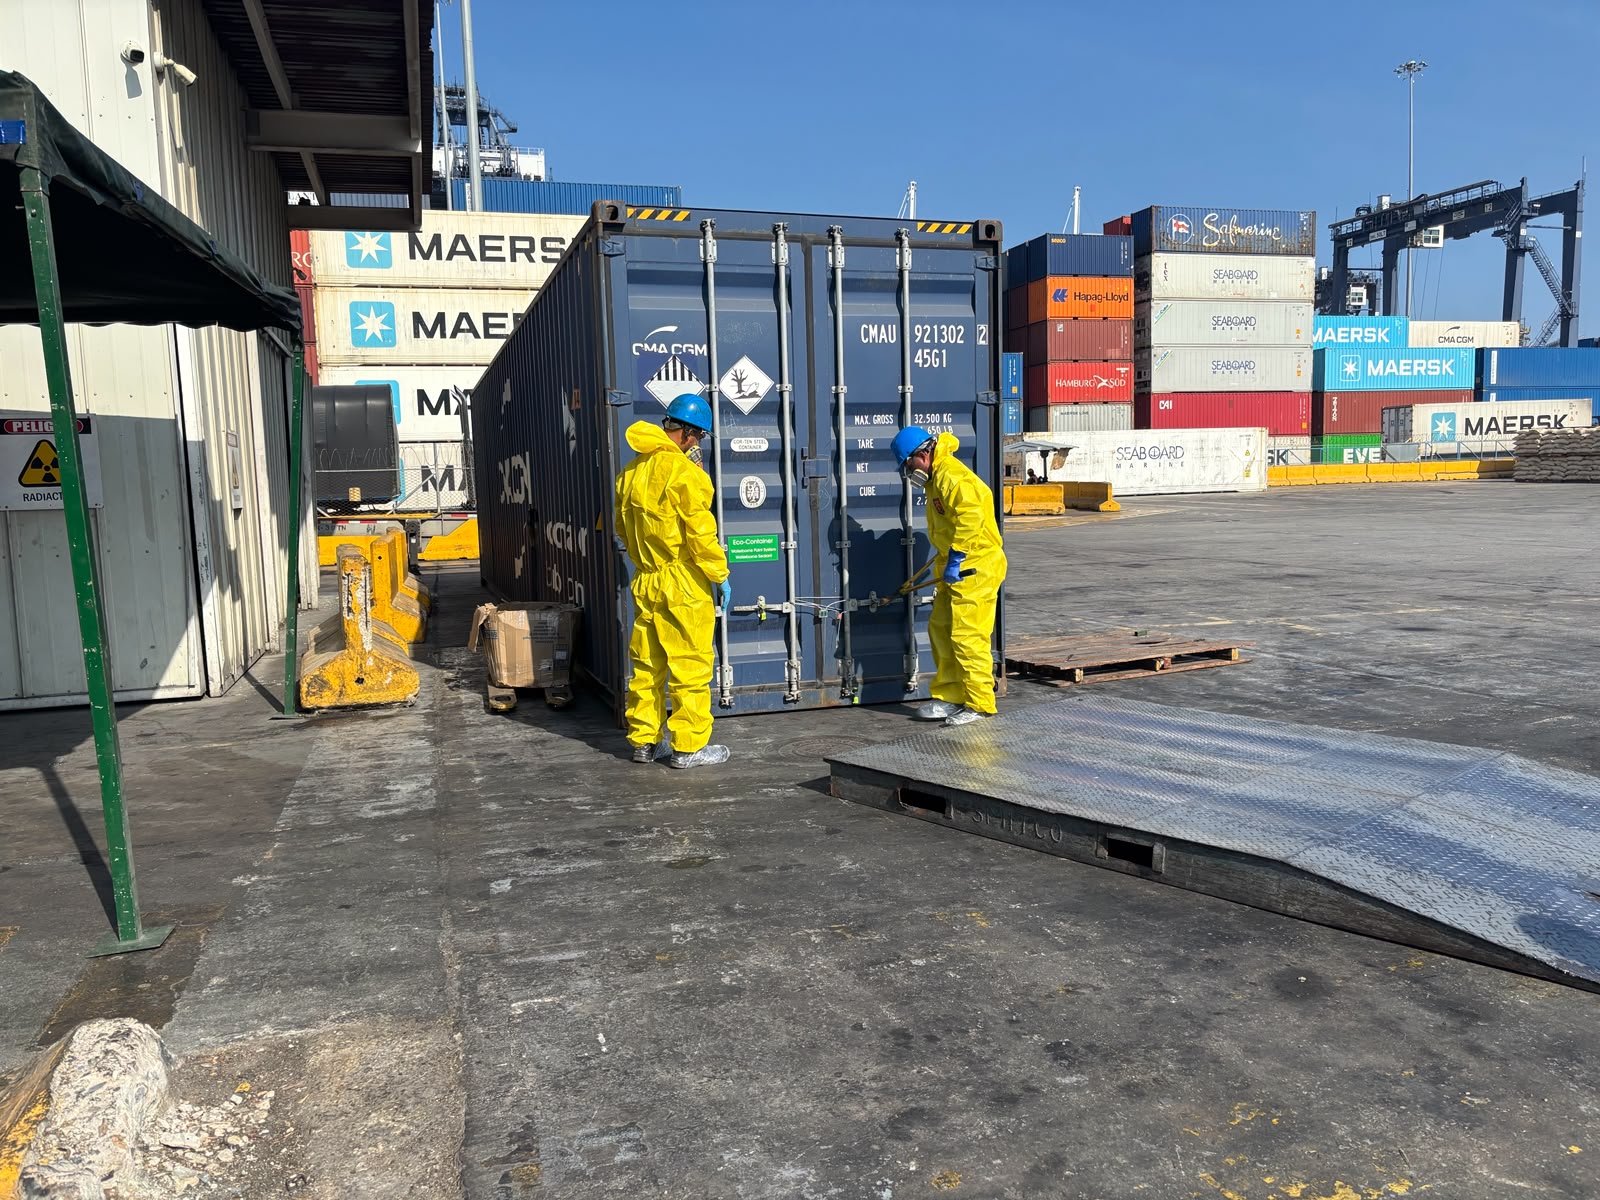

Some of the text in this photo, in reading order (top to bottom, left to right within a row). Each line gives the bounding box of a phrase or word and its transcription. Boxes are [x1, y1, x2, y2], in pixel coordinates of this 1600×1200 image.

[408, 233, 574, 263] MAERS
[1213, 269, 1258, 280] SEABOARD
[1074, 292, 1128, 303] Hapag-Lloyd
[412, 312, 525, 339] MAE
[1212, 316, 1256, 327] SEABOARD
[861, 324, 986, 344] CMAU 921302 2
[1438, 336, 1474, 344] CMA CGM
[632, 343, 707, 356] CMA CGM
[914, 349, 947, 367] 45G1
[1212, 360, 1255, 370] SEABOARD
[1367, 360, 1455, 377] MAERSK
[1056, 379, 1095, 388] HAMBURG
[1159, 400, 1172, 410] CAI
[855, 413, 952, 425] MAX. GROSS 32.500 KG
[12, 421, 55, 432] PELIG
[1465, 414, 1568, 436] MAERSK
[858, 439, 874, 449] TARE
[1116, 446, 1184, 460] SEABOARD
[1343, 448, 1381, 463] EVE
[856, 463, 868, 472] NET
[23, 493, 62, 501] RADIACT
[860, 486, 876, 497] CUBE
[732, 538, 773, 546] Eco-Container
